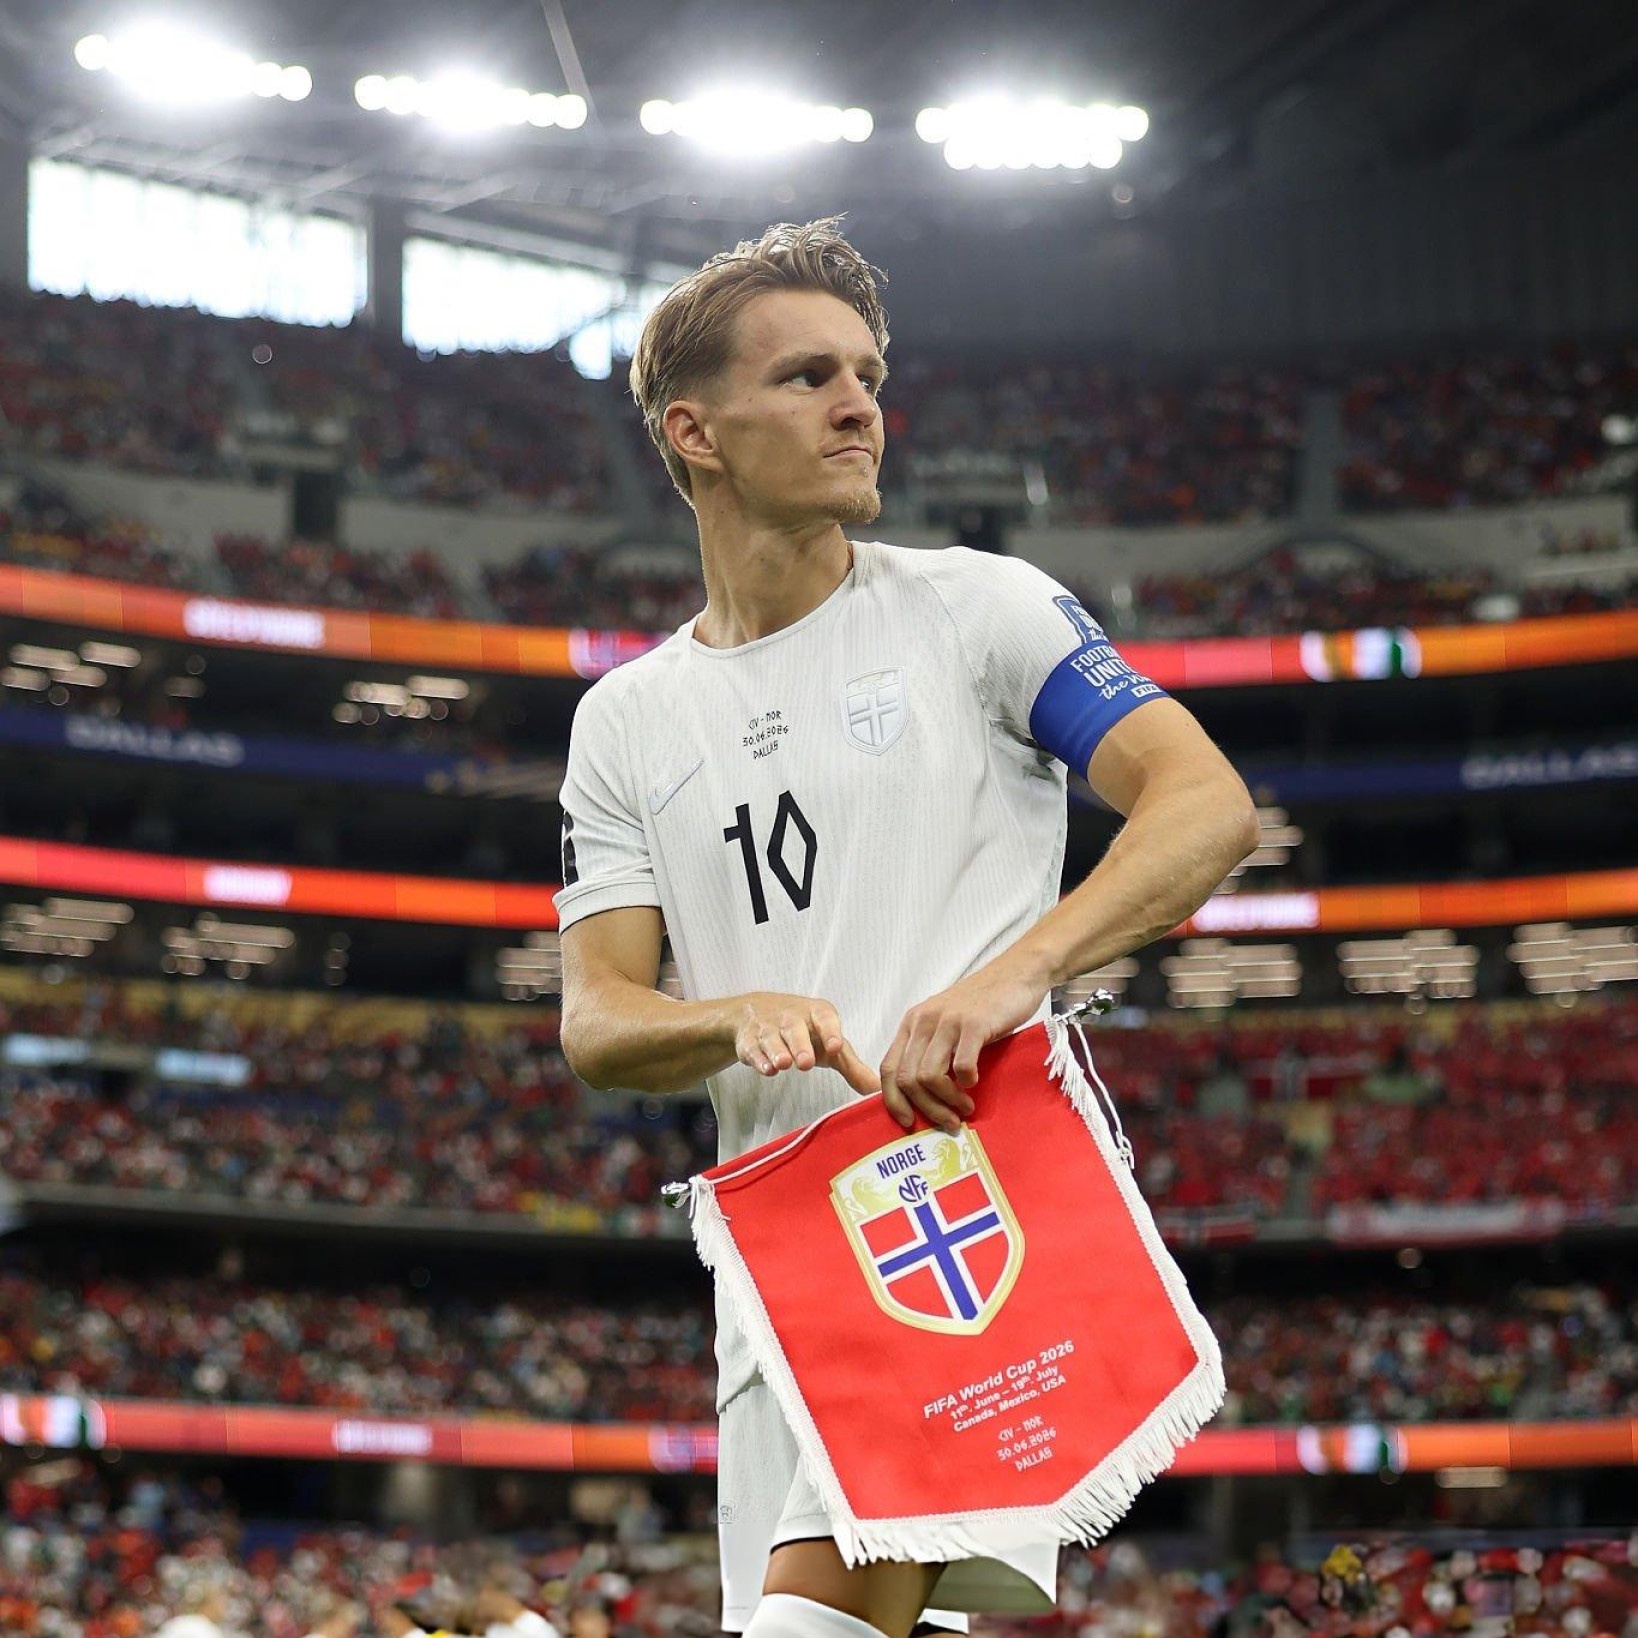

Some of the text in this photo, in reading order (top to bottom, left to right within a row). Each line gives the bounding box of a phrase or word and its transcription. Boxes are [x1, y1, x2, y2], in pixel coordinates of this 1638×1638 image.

[1070, 645, 1122, 673] FOOTB
[1084, 658, 1138, 687] UNIT
[753, 739, 779, 760] DALLAS
[723, 790, 818, 925] 10
[876, 1143, 926, 1179] NORGE
[923, 1340, 1075, 1419] FIFA World Cup 2026
[973, 1392, 1001, 1410] June
[1036, 1365, 1059, 1382] July
[953, 1374, 1067, 1432] Canada, Mexico, USA
[996, 1426, 1057, 1461] 30.06.2026
[1014, 1446, 1053, 1472] DALLAS
